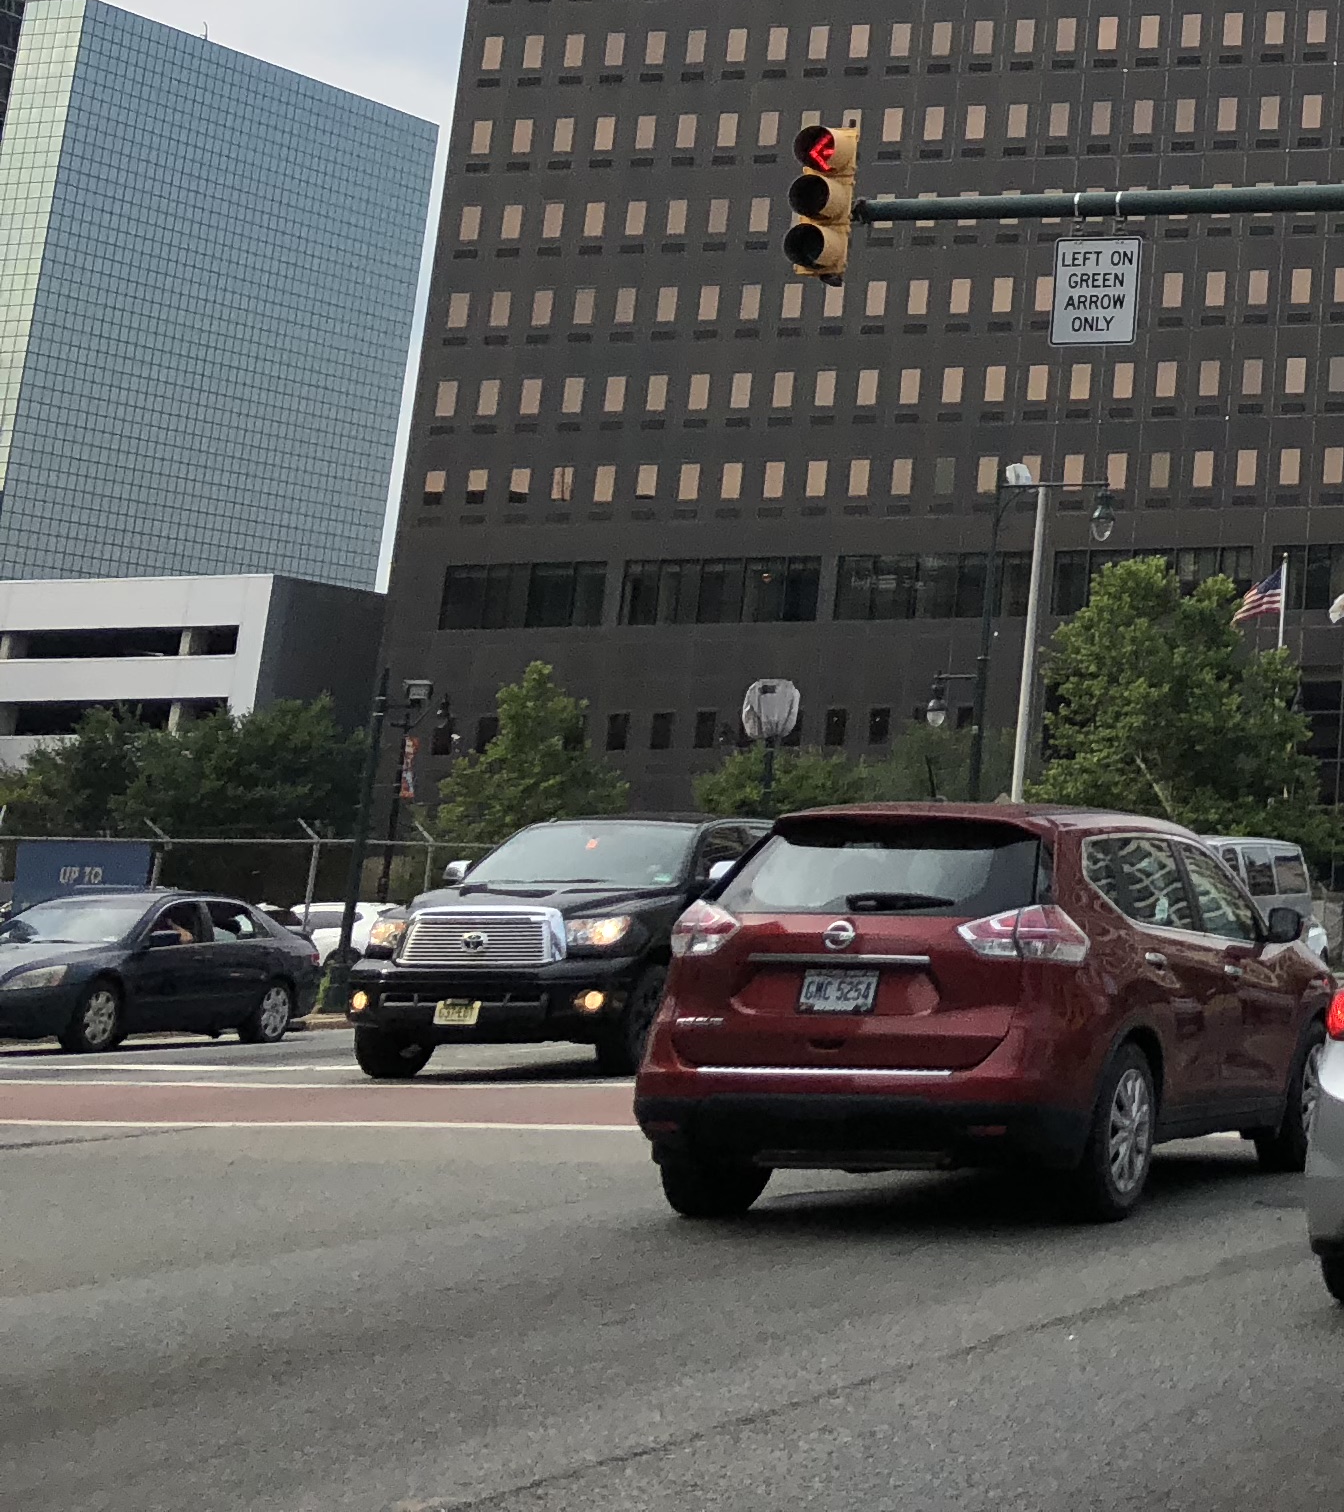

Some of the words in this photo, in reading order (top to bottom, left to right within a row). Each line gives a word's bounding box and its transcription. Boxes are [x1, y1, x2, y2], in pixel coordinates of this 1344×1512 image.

[1061, 251, 1103, 267] LEFT
[1111, 250, 1134, 266] ON
[1068, 272, 1125, 289] GREEN
[1063, 293, 1126, 310] ARROW
[1071, 315, 1115, 332] ONLY
[59, 866, 80, 884] UP
[84, 866, 103, 884] TO
